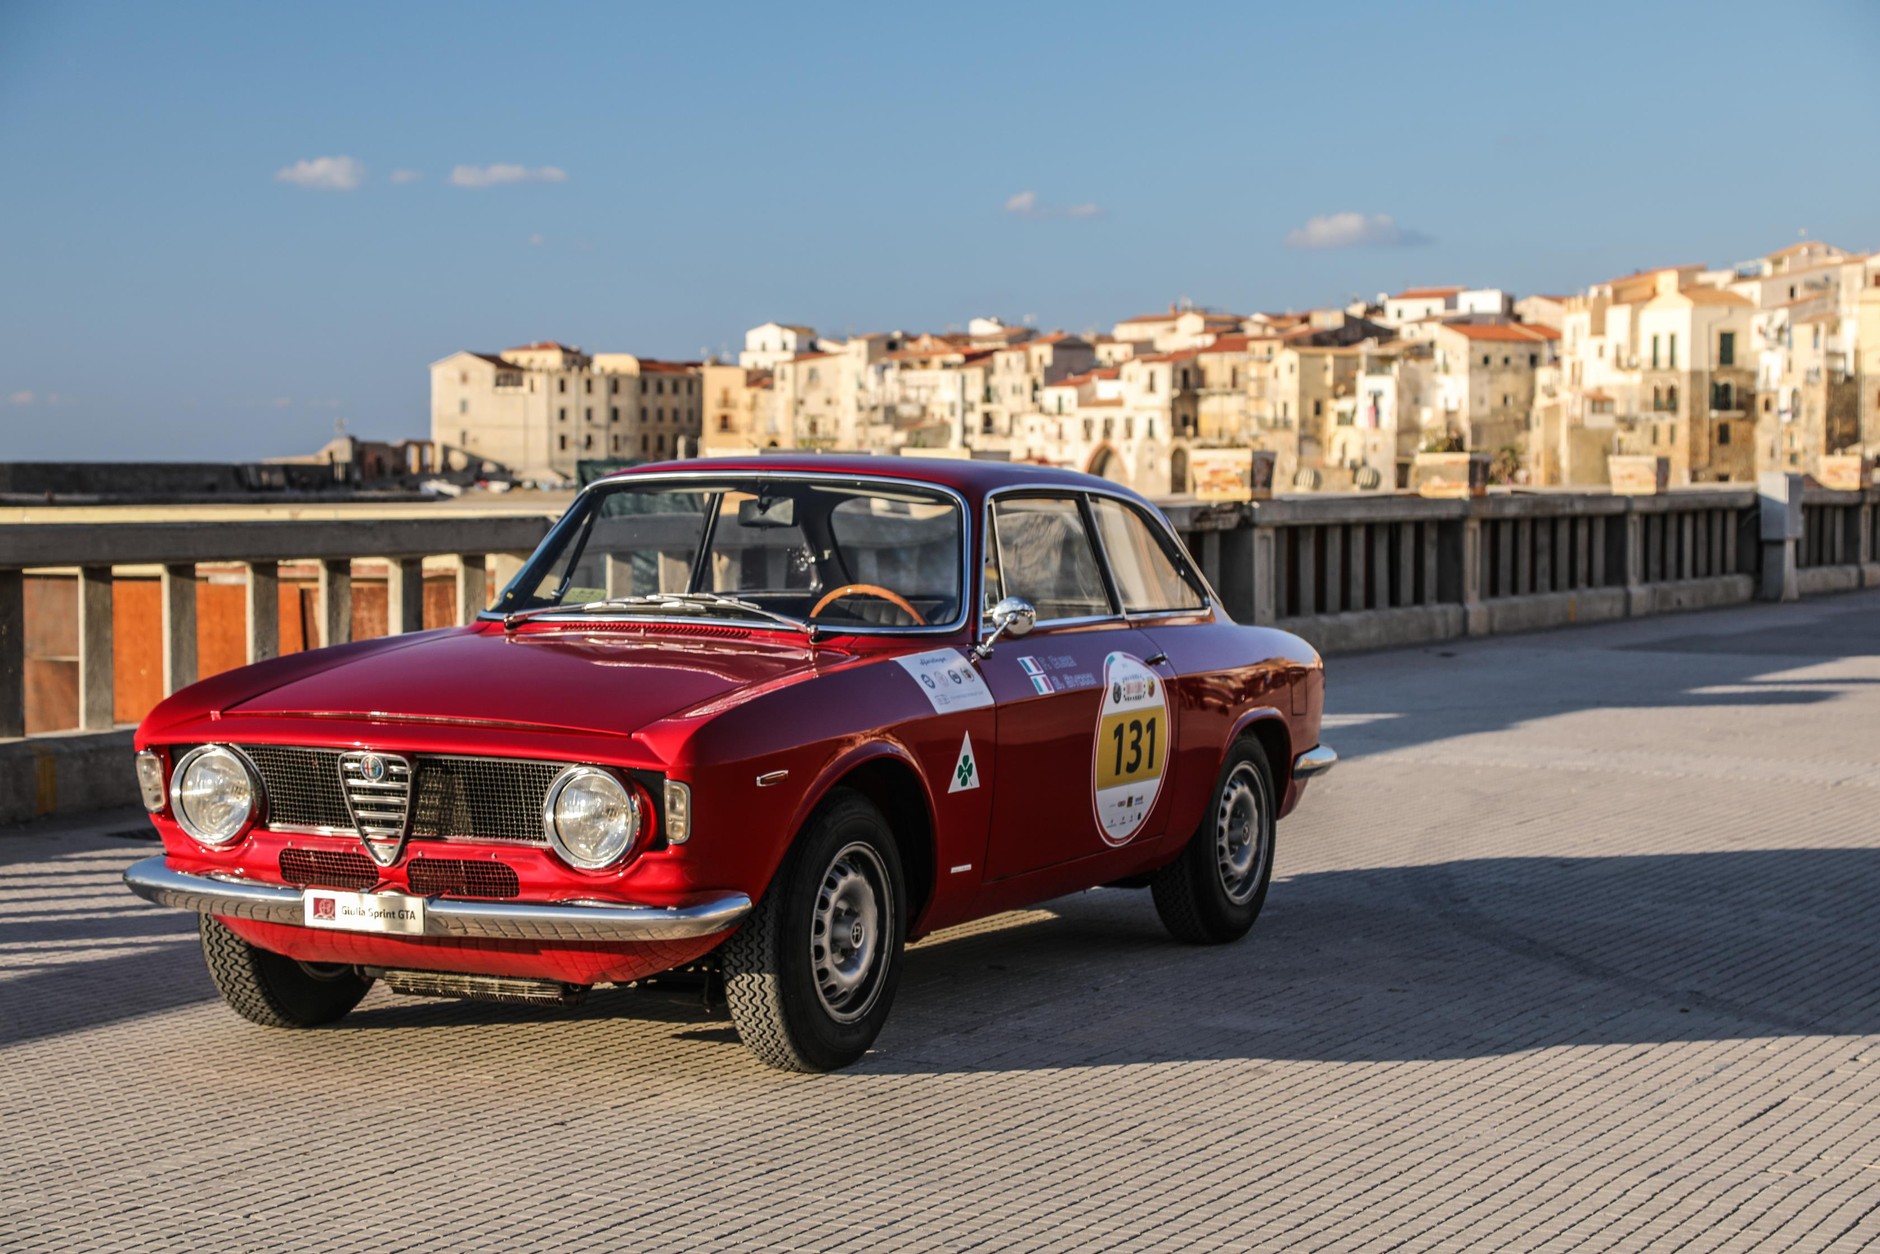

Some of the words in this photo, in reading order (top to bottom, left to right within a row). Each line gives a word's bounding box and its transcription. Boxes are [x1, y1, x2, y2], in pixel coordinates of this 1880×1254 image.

[1113, 717, 1156, 776] 131
[341, 905, 366, 917] Giulia
[368, 908, 395, 920] Sprint
[397, 909, 416, 920] GTA
